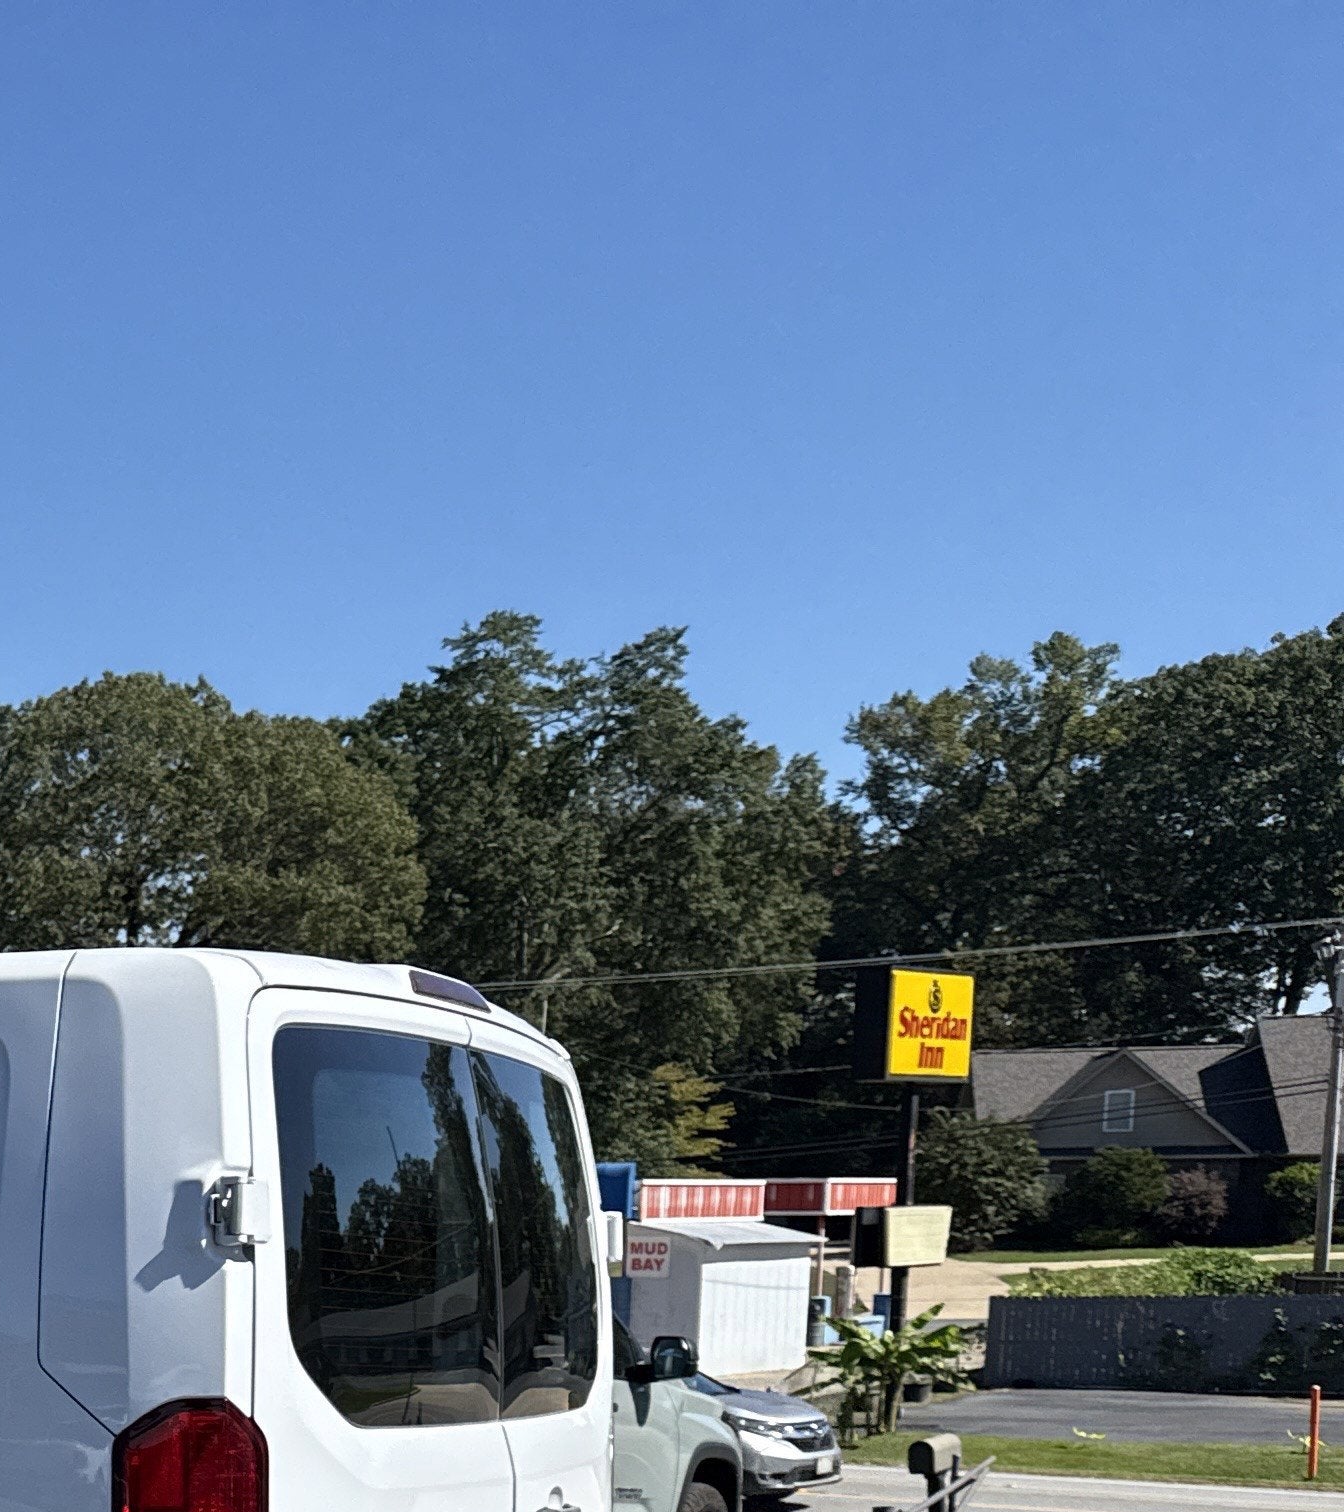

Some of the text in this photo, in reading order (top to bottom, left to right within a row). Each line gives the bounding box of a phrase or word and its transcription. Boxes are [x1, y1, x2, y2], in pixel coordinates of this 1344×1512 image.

[898, 1006, 967, 1040] Sheridan
[918, 1042, 944, 1068] Inn
[630, 1242, 668, 1255] MUD
[631, 1258, 664, 1271] BAY
